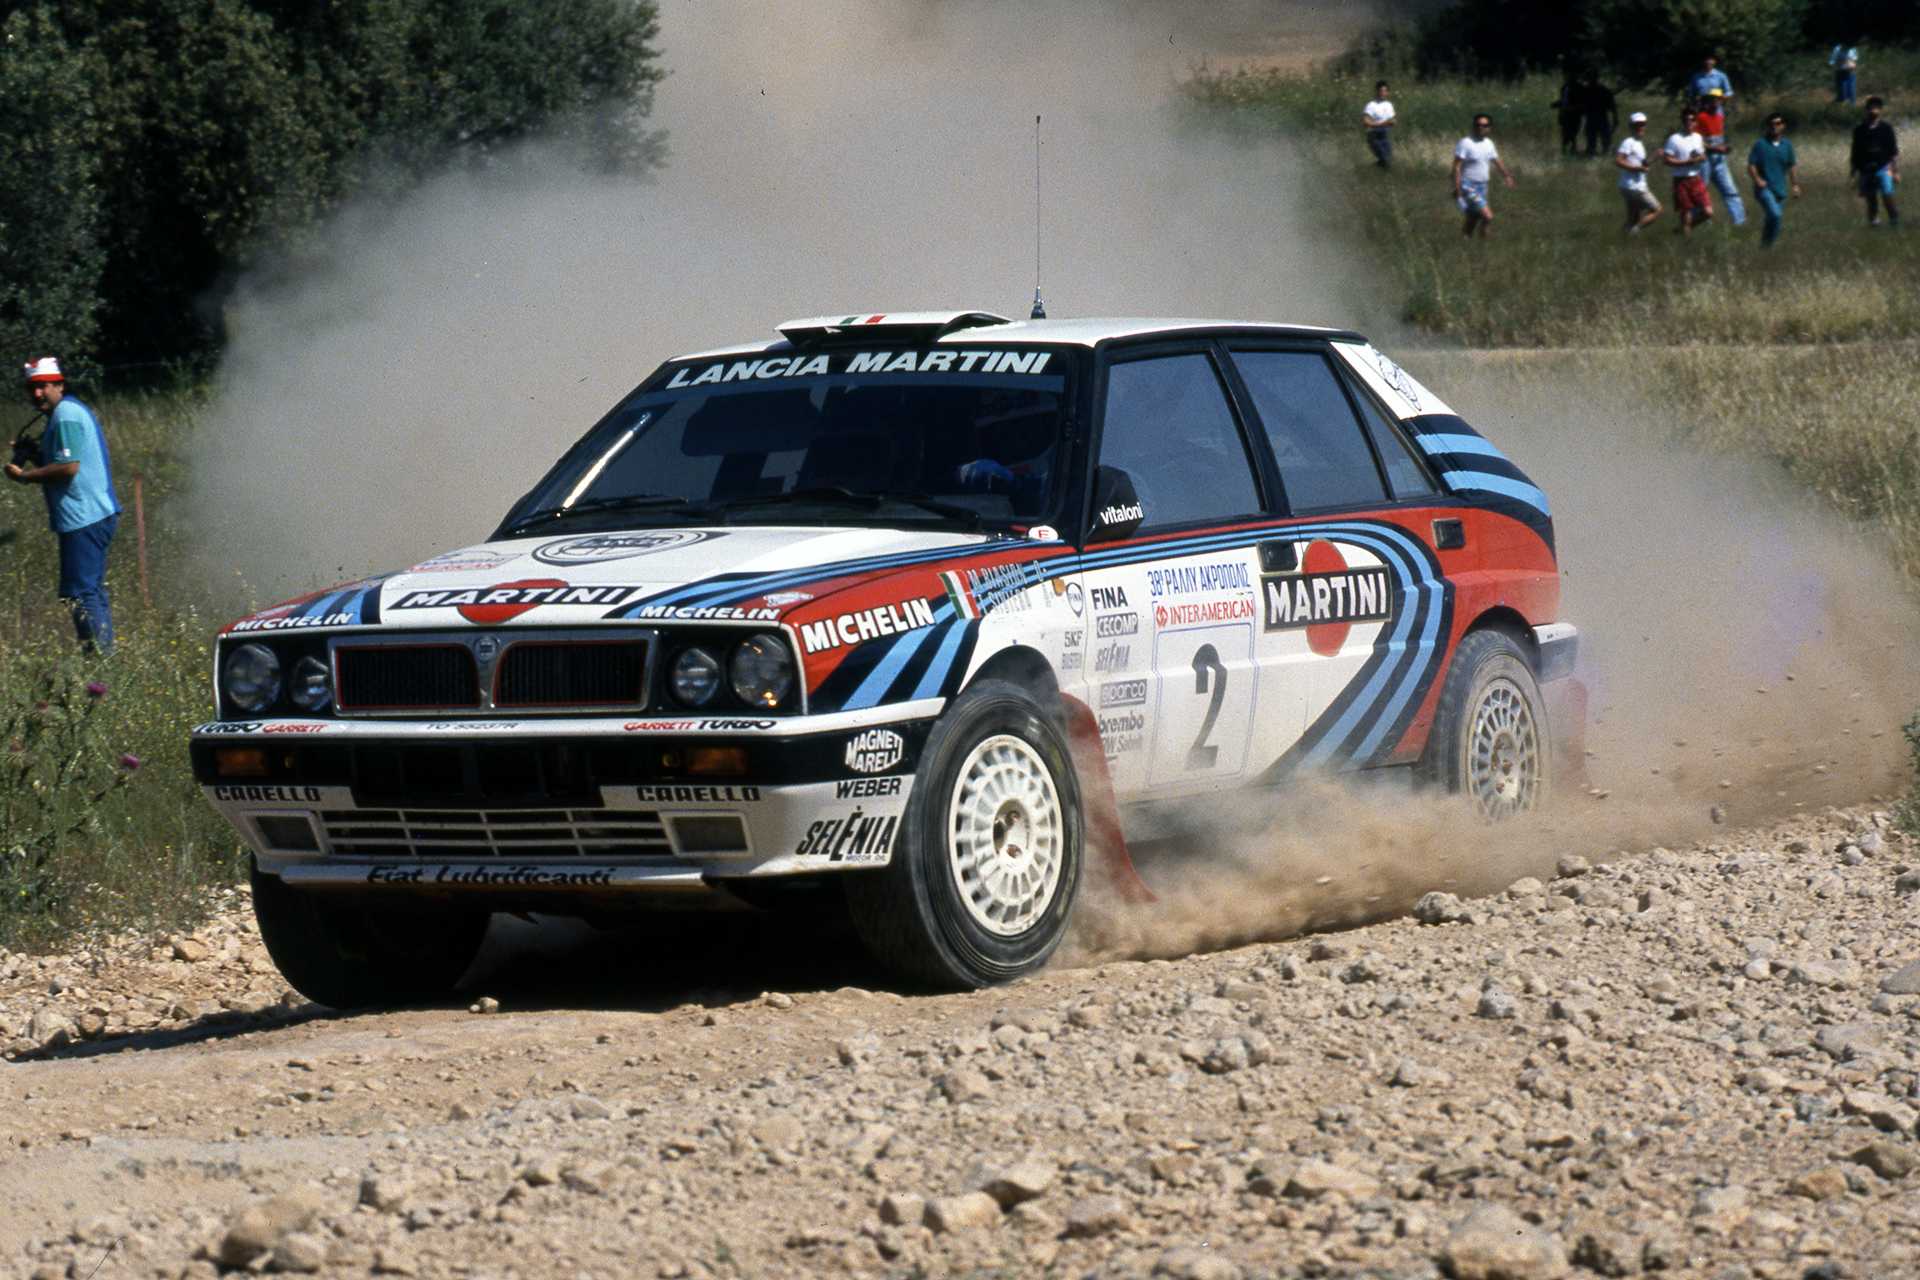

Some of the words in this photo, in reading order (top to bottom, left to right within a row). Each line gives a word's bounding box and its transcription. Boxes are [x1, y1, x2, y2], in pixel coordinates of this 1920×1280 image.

[666, 353, 831, 390] LANCIA
[845, 350, 1052, 375] MARTINI
[1100, 502, 1144, 525] vitaloni
[402, 587, 627, 607] MARTINI
[1091, 586, 1128, 610] FINA
[1267, 574, 1387, 623] MARTINI
[233, 612, 353, 631] MICHELIN
[639, 605, 781, 619] MICHELIN
[1170, 600, 1254, 625] INTERAMERICAN
[800, 597, 935, 654] MICHELIN
[1097, 614, 1137, 637] CECOMP
[1064, 631, 1083, 648] SKF
[1185, 643, 1228, 770] 2
[262, 724, 328, 734] GARRETT
[624, 721, 694, 731] GARRETT
[698, 719, 777, 731] TURBO
[1099, 710, 1144, 733] brembo
[215, 786, 320, 801] CARELLO
[636, 786, 761, 801] CARELLO
[836, 777, 902, 798] WEBER
[367, 865, 424, 885] Fiat
[436, 865, 616, 886] Lubrificanti
